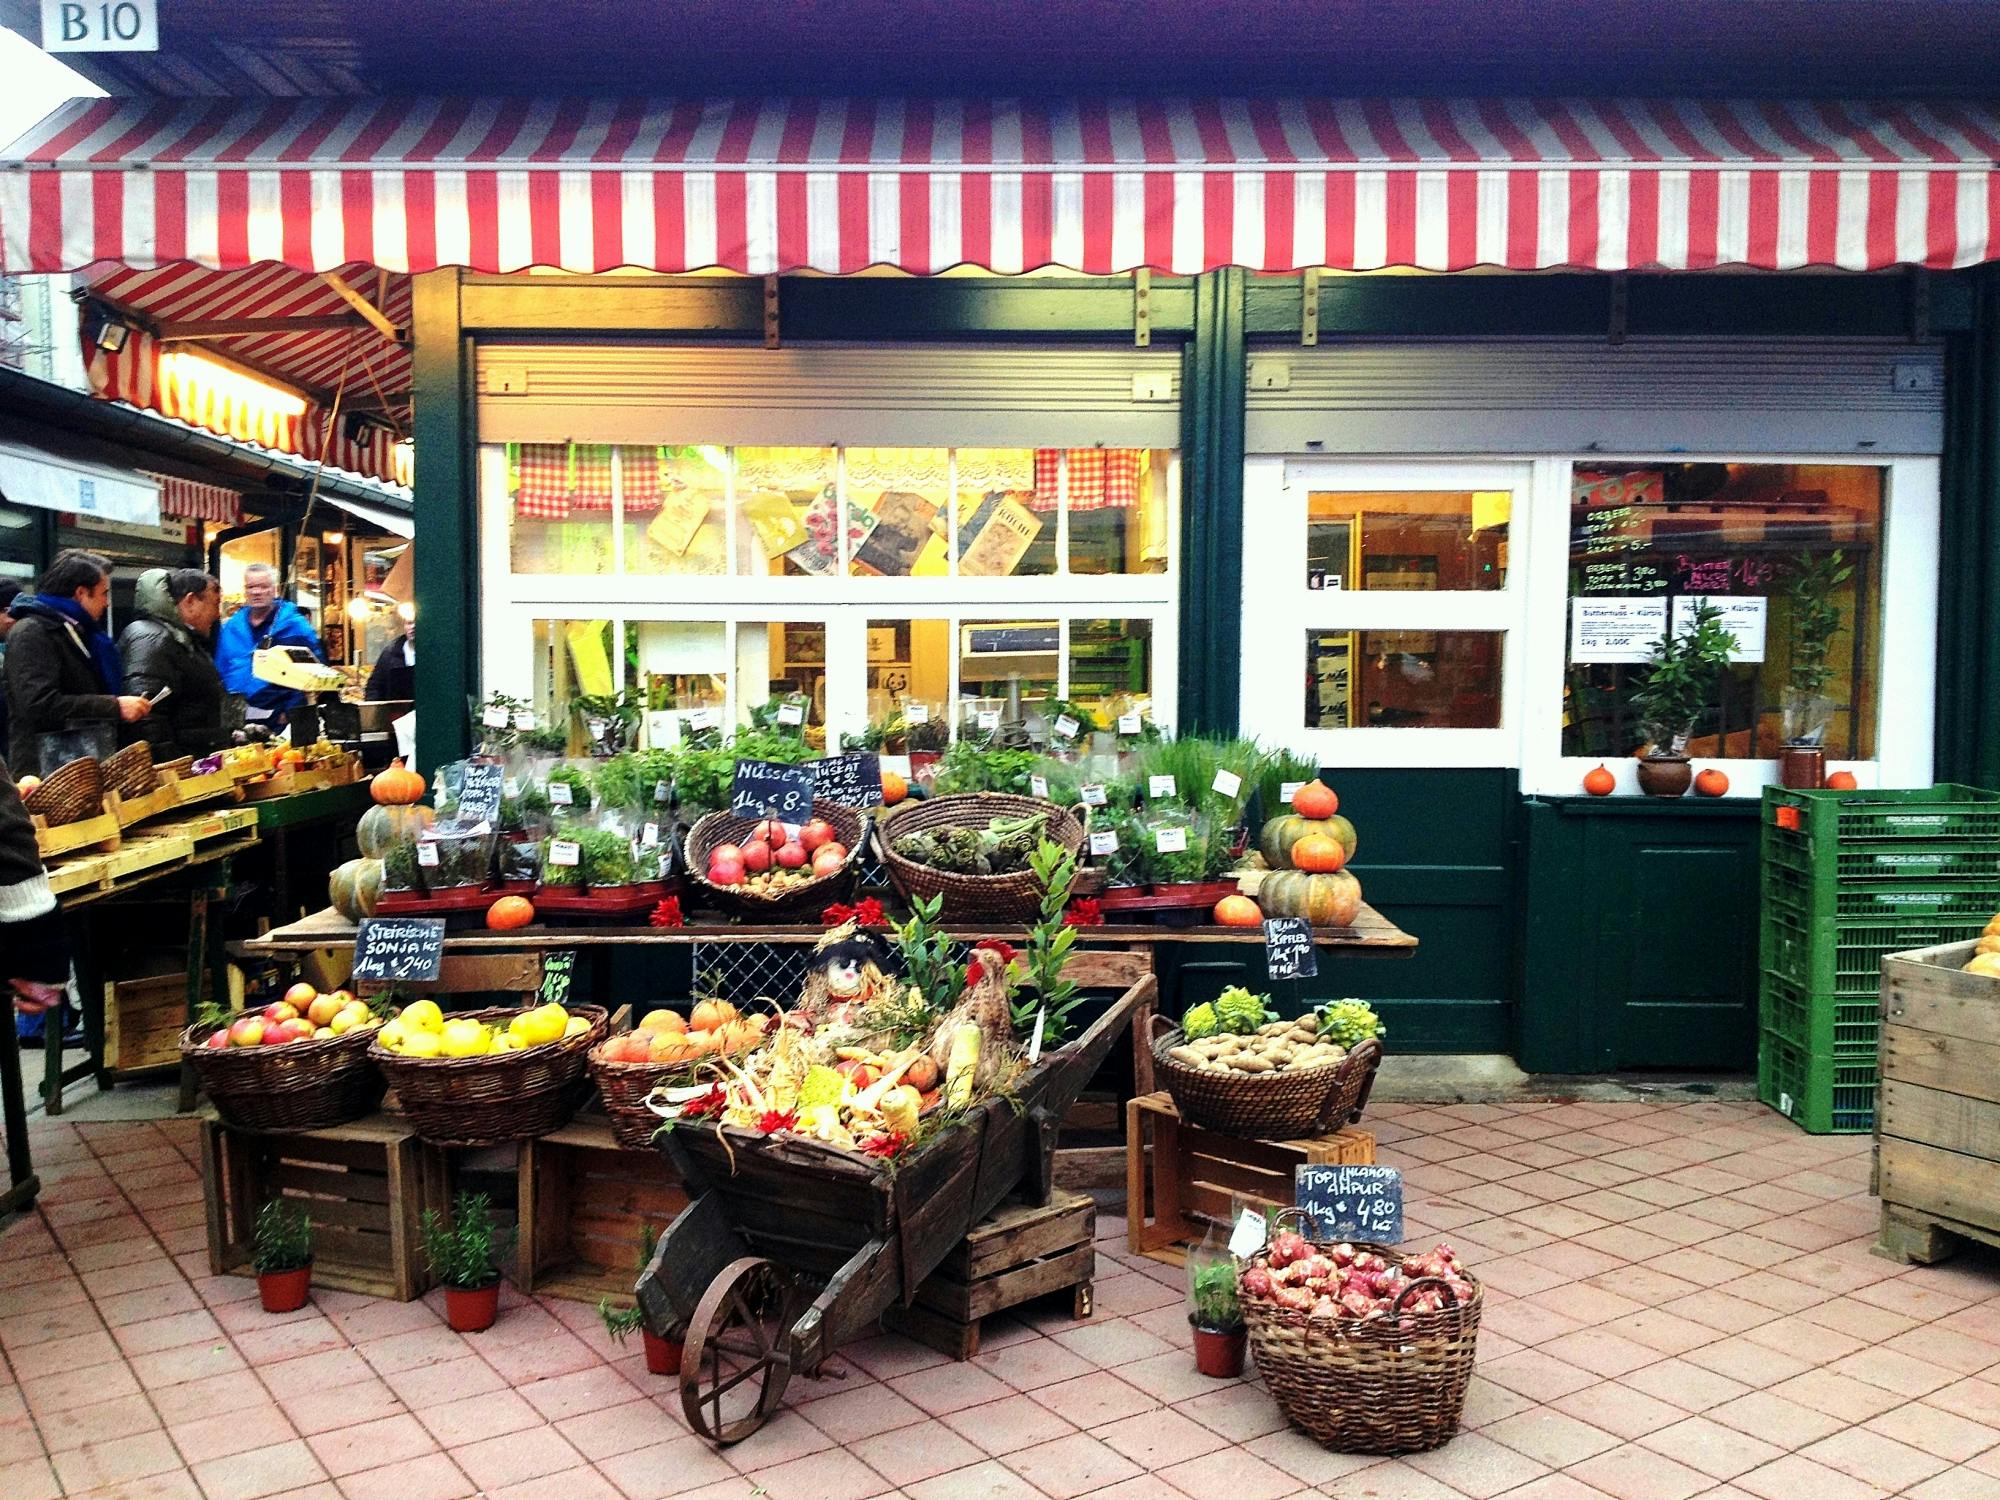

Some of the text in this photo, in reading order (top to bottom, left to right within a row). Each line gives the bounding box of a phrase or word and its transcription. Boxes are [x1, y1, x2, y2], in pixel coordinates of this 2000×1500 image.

[61, 2, 141, 42] B 10
[736, 761, 802, 783] NÜSSE
[733, 789, 766, 817] 1kg
[352, 955, 385, 977] 1kg
[1304, 1199, 1337, 1225] 1kg
